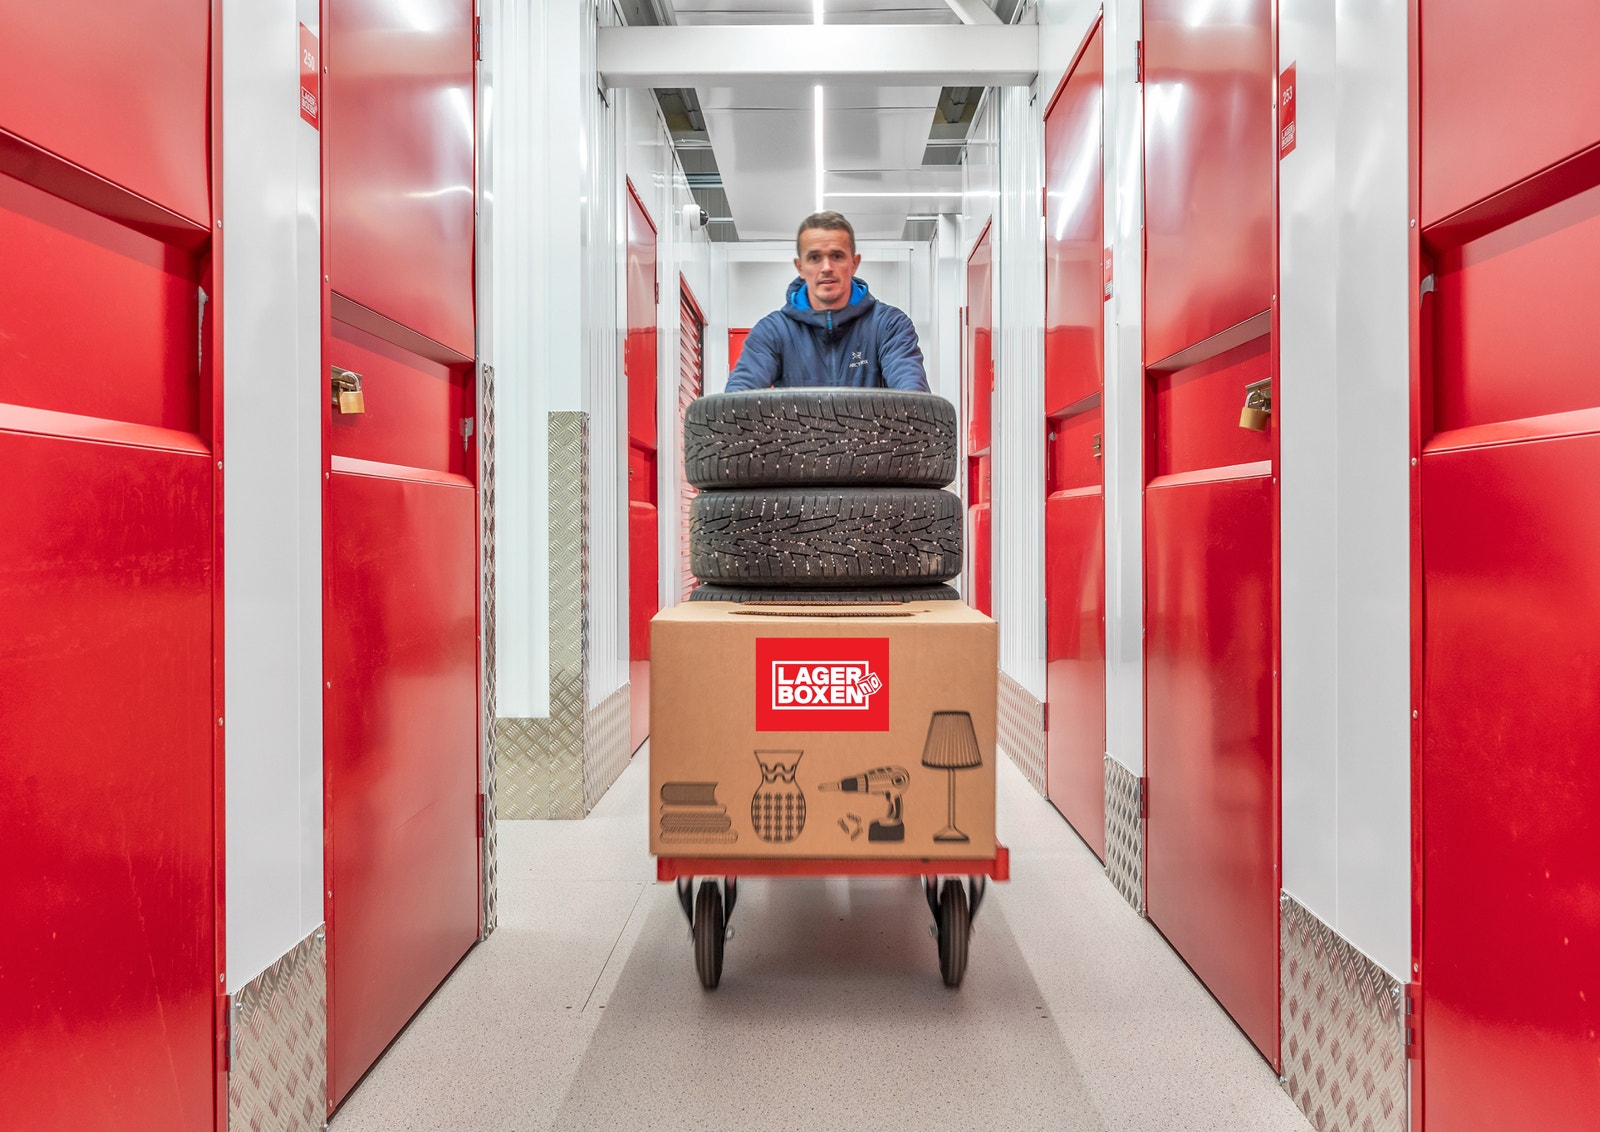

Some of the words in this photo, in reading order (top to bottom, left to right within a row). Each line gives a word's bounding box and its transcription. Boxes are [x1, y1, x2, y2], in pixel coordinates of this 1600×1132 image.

[1282, 85, 1293, 107] 253
[778, 666, 862, 685] LAGER
[778, 685, 863, 704] BOXEN
